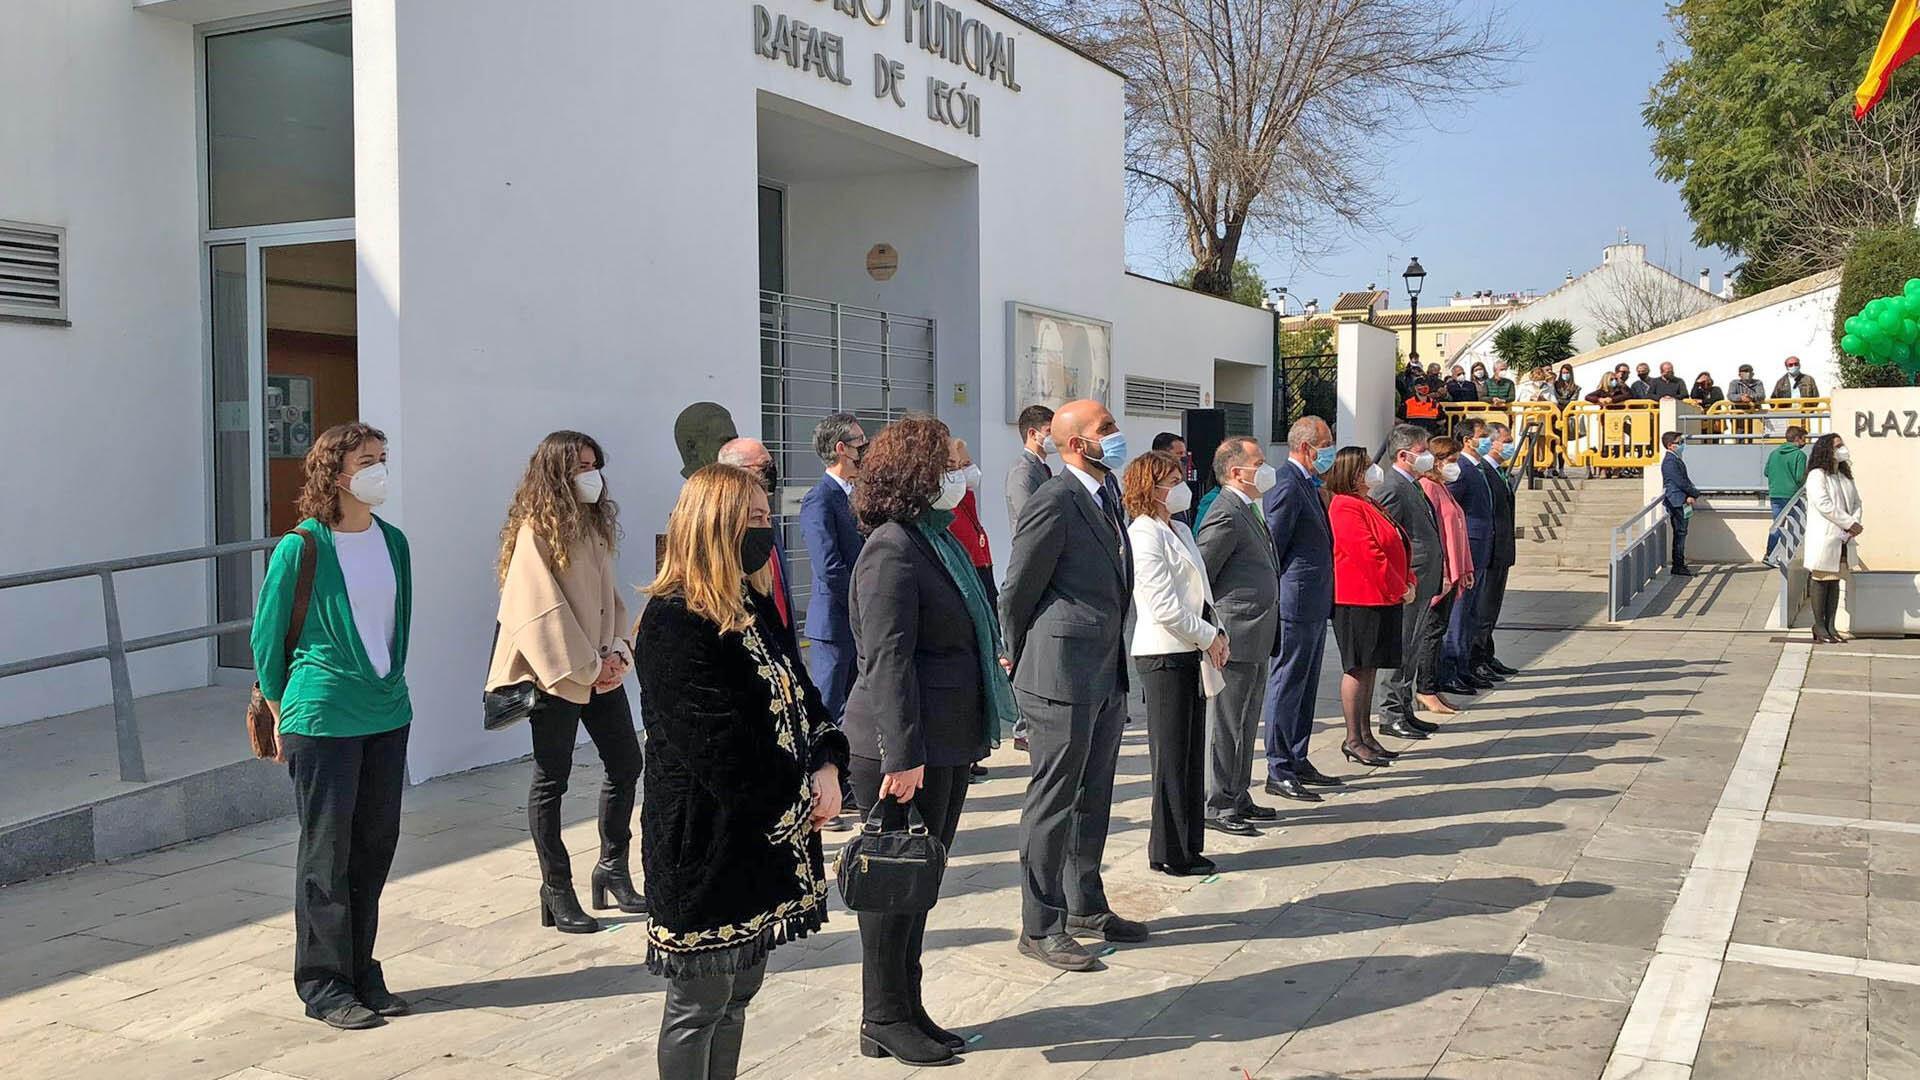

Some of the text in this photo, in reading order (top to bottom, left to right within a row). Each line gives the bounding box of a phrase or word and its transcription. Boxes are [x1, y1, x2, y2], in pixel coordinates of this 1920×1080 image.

[754, 4, 852, 86] RAFAEL
[874, 53, 905, 107] DE
[927, 76, 981, 137] LEÓN
[905, 0, 1021, 92] MUNICIPAL
[1855, 409, 1920, 438] PLAZ
